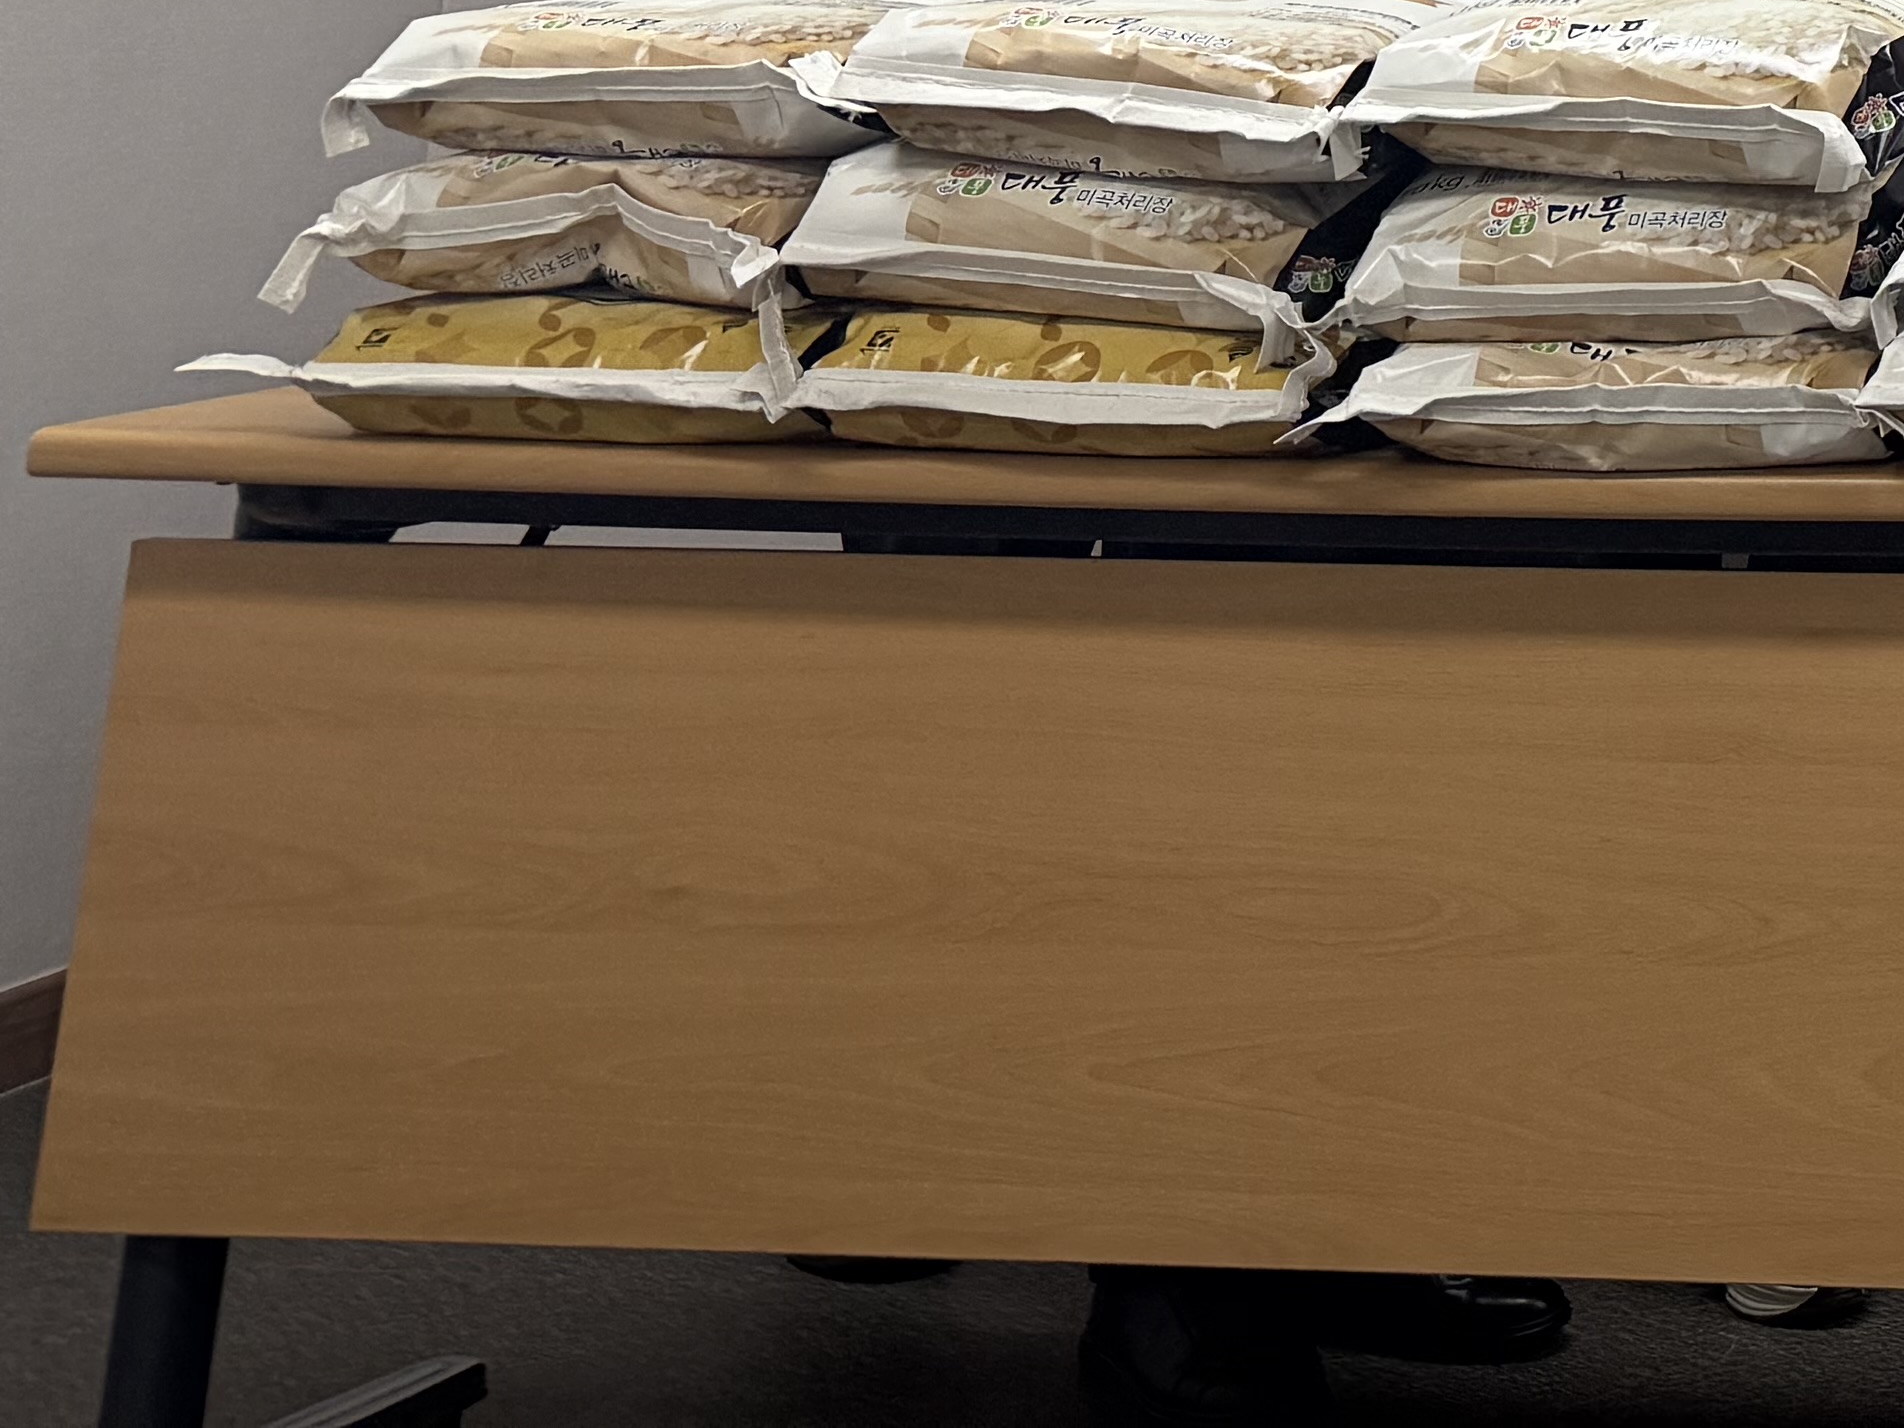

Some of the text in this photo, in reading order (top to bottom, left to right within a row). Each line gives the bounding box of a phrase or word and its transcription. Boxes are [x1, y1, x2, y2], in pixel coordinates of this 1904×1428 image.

[1000, 169, 1176, 215] 대풍 미곡처리장
[1546, 194, 1729, 233] 대풍 미곡처리장
